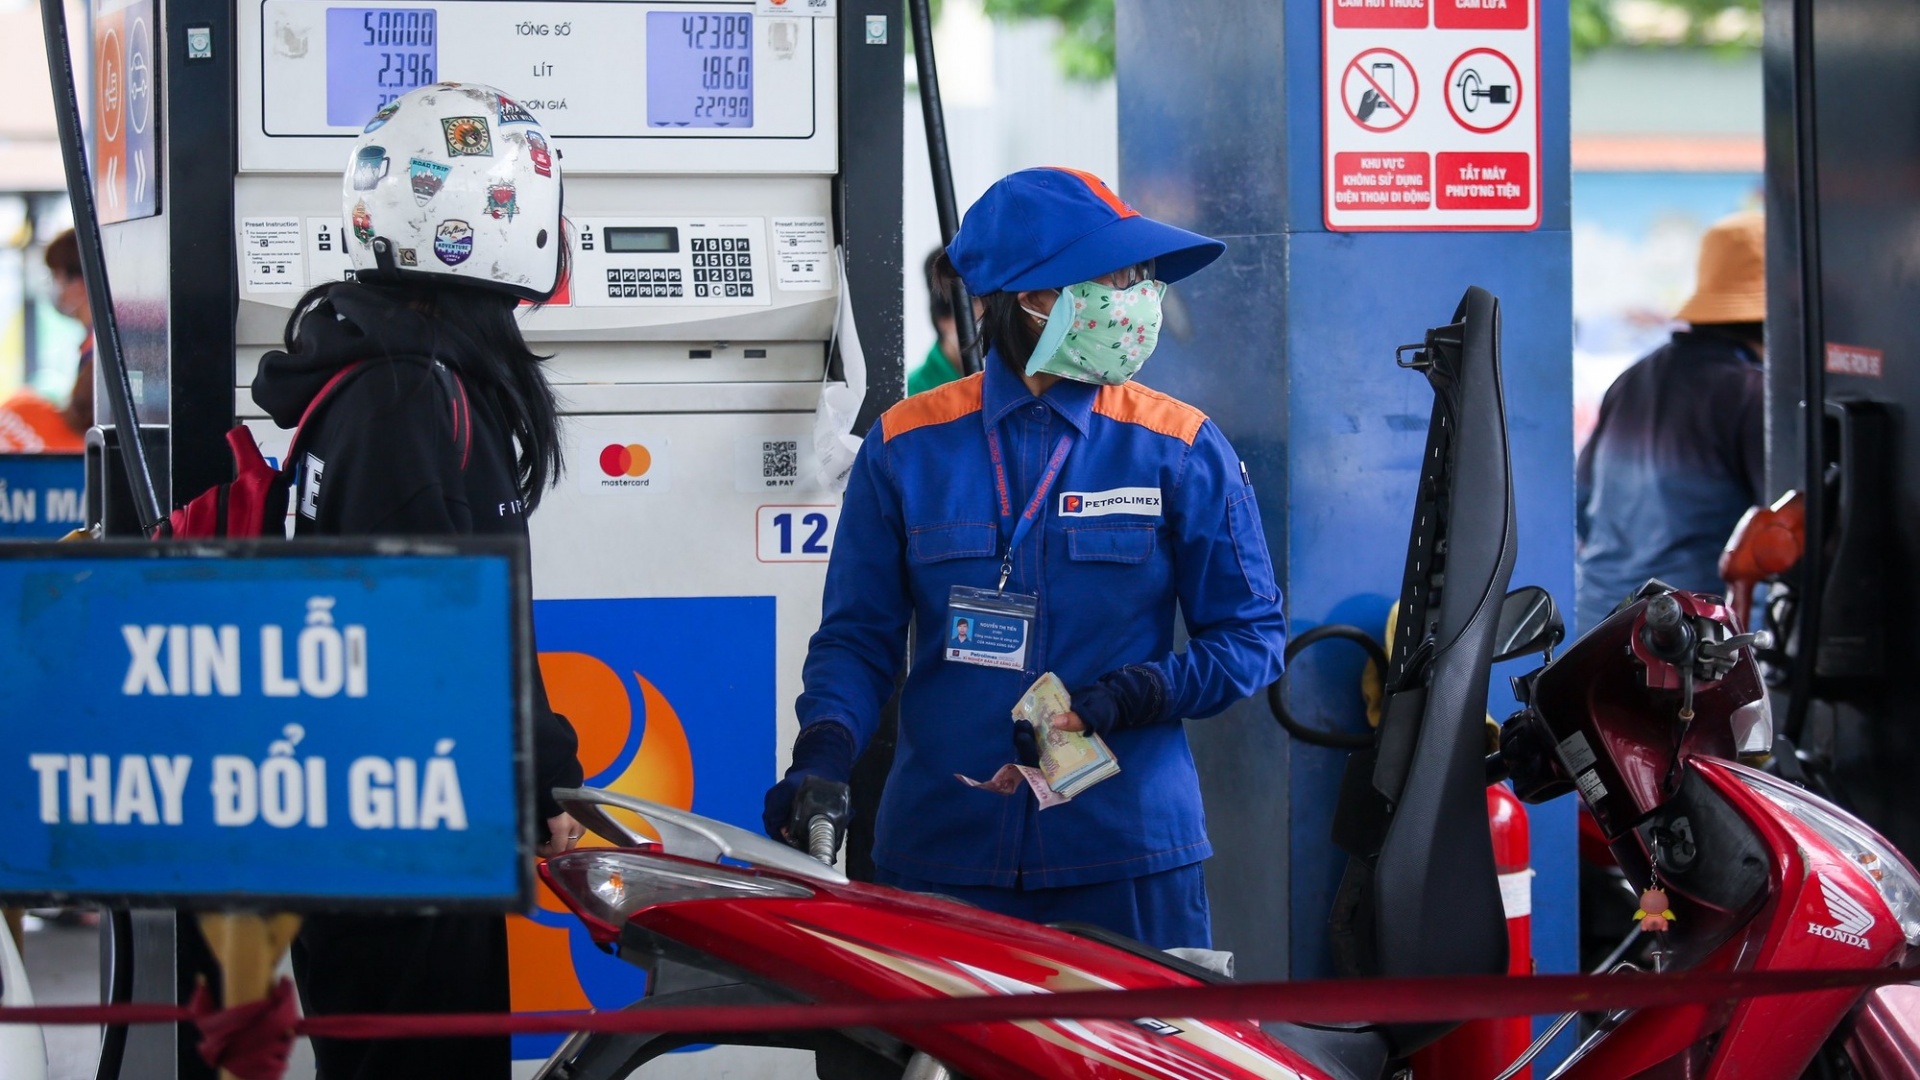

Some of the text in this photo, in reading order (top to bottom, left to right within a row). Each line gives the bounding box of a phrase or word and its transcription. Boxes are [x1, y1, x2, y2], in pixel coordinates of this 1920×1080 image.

[364, 12, 433, 46] 50000
[516, 21, 572, 36] TỔNG SỐ
[682, 16, 749, 49] 42389
[534, 62, 553, 77] LÍT
[548, 98, 568, 110] GIÁ
[695, 96, 749, 118] 22790
[412, 160, 449, 172] ROAD TRIP
[1361, 158, 1381, 169] KHU
[1343, 172, 1376, 186] KHÔNG
[1396, 174, 1422, 188] DỤNG
[1482, 166, 1506, 180] MÁY
[1360, 191, 1389, 205] THOẠI
[1391, 192, 1401, 202] DI
[1446, 182, 1520, 200] PHƯƠNG TIỆN
[440, 224, 468, 238] Rafting
[694, 241, 701, 250] 7
[709, 241, 717, 250] 8
[724, 241, 732, 250] 9
[695, 256, 703, 265] 4
[711, 256, 718, 266] 5
[726, 256, 733, 266] 6
[608, 272, 680, 280] P1 P2 P3 P4 P5
[698, 271, 751, 280] 1 2 3 F3
[610, 287, 683, 296] P6 P7 P8 P9 P10
[698, 286, 752, 296] 0 C F4
[601, 478, 650, 487] mastercard
[996, 464, 1010, 517] Petrolimex
[1024, 470, 1056, 520] Petrolimex
[1085, 496, 1160, 508] PETROLIMEX
[774, 513, 828, 554] 12
[122, 596, 368, 698] XIN LỖI
[28, 723, 469, 830] THAY ĐỔI GIÁ
[1807, 922, 1870, 950] HONDA
